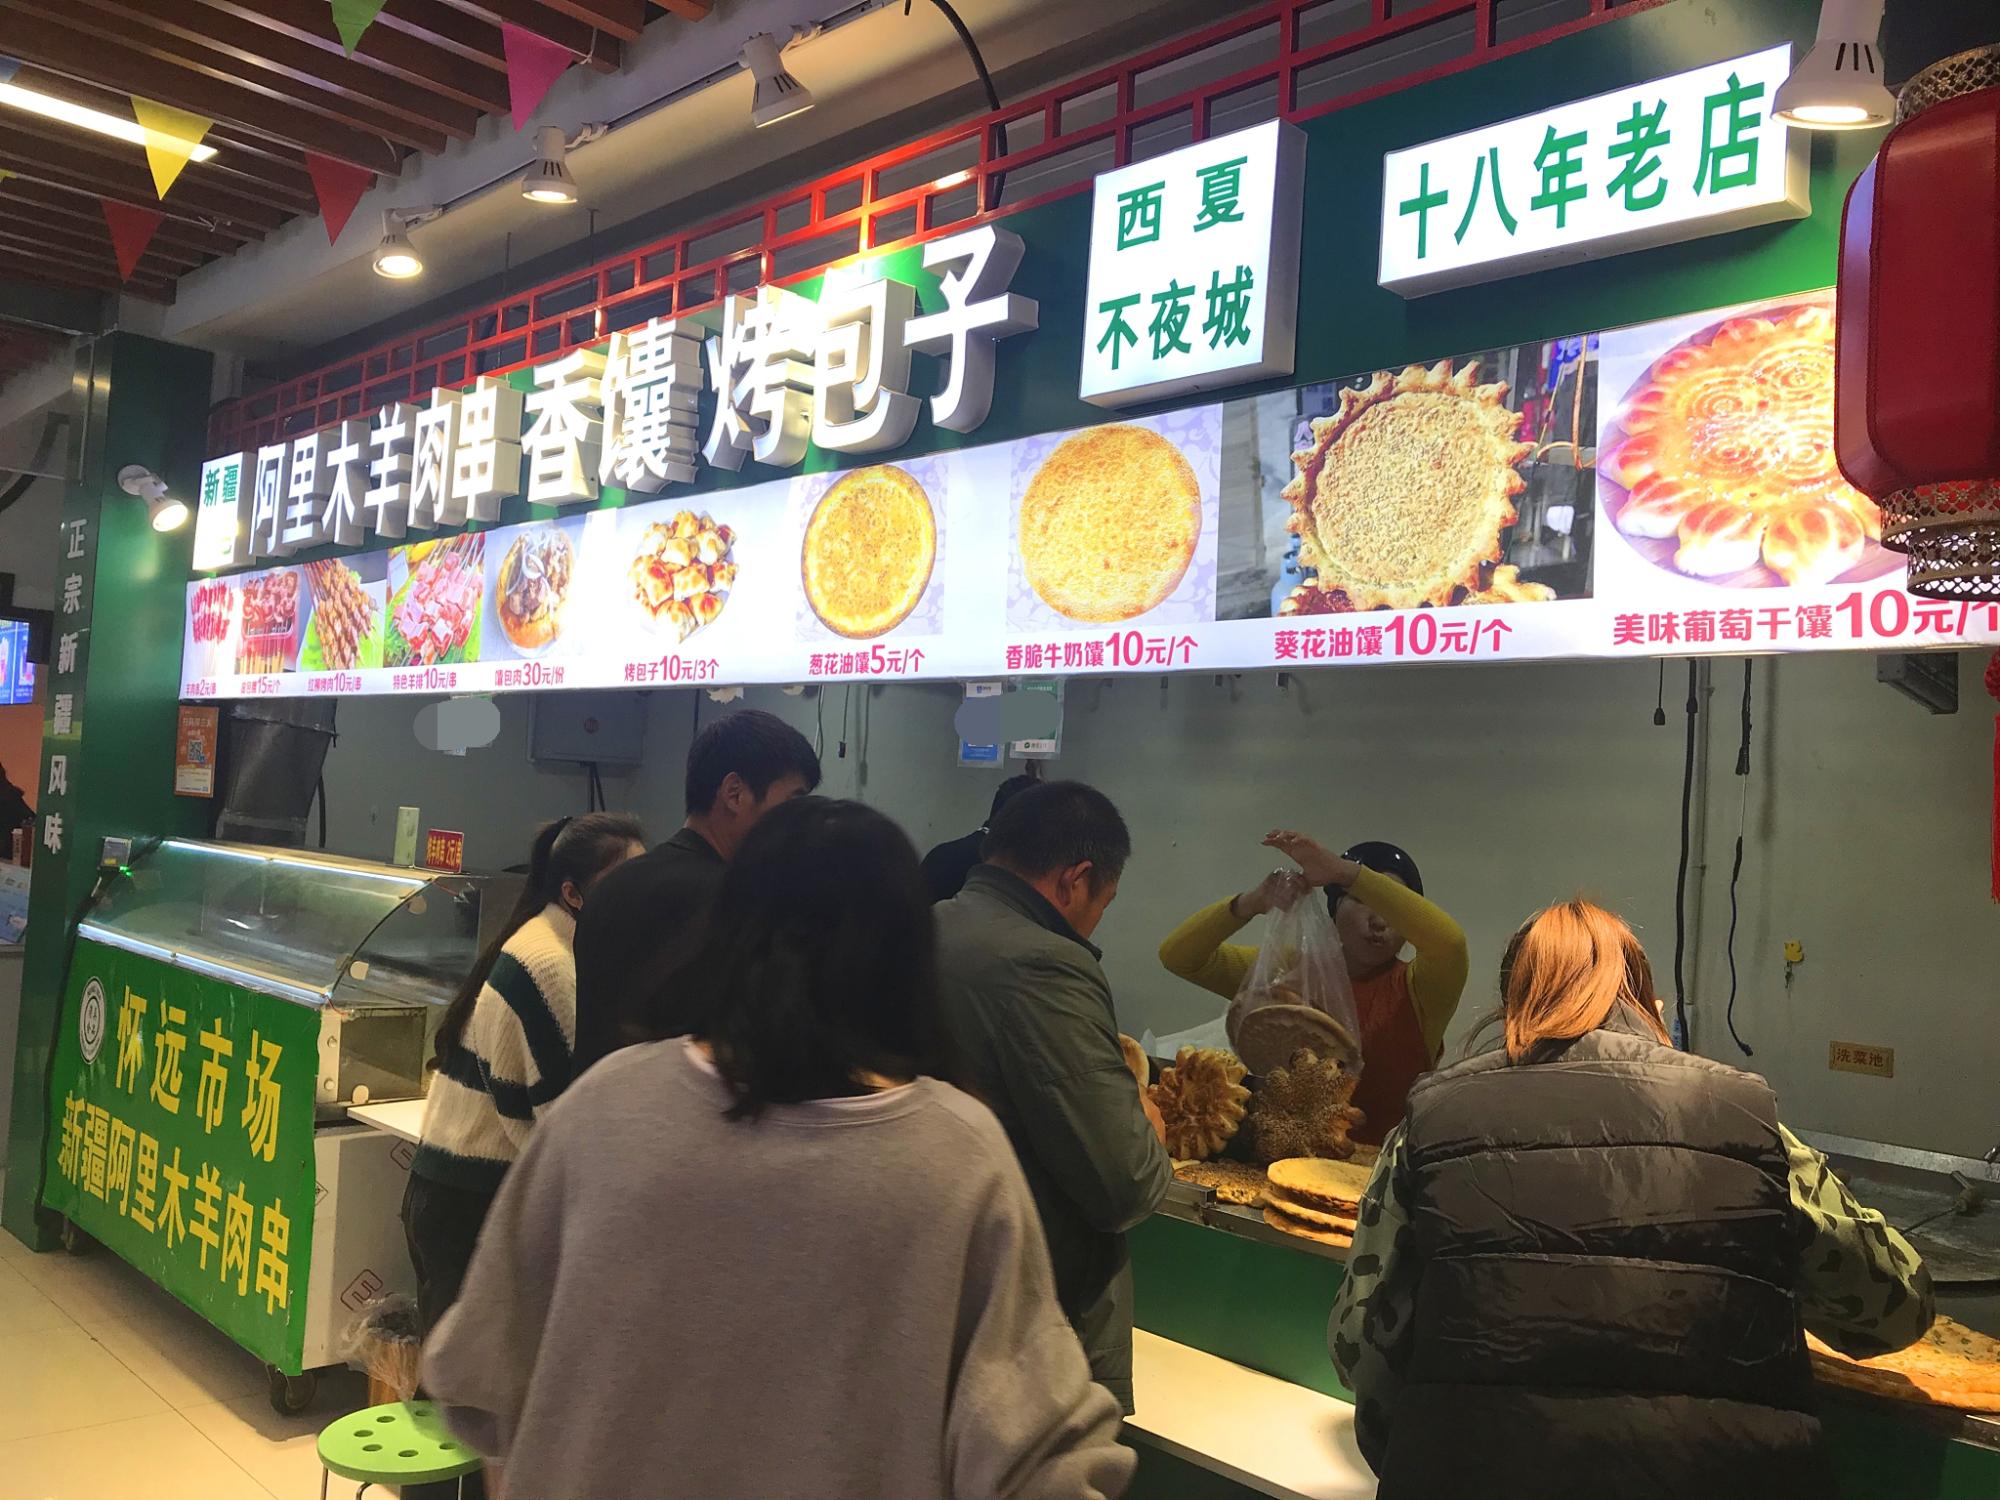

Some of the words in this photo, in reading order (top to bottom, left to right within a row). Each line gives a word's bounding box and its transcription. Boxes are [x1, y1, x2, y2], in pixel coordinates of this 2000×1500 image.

[1399, 71, 1766, 259] 十八年老店
[1117, 156, 1248, 251] 西夏
[1097, 265, 1254, 370] 不夜城
[204, 464, 239, 507] 新疆
[624, 655, 719, 681] 烤包子10元/3个
[809, 644, 925, 675] 葱花油馕5元/个
[1006, 630, 1198, 669] 香脆牛奶馕10元/个
[1275, 613, 1512, 660] 葵花油馕10元/个
[44, 518, 87, 854] 正宗新疆风味
[115, 986, 283, 1162] 怀远市场
[1836, 1048, 1884, 1067] 洗菜池
[57, 1090, 291, 1316] 新疆阿里木羊肉串
